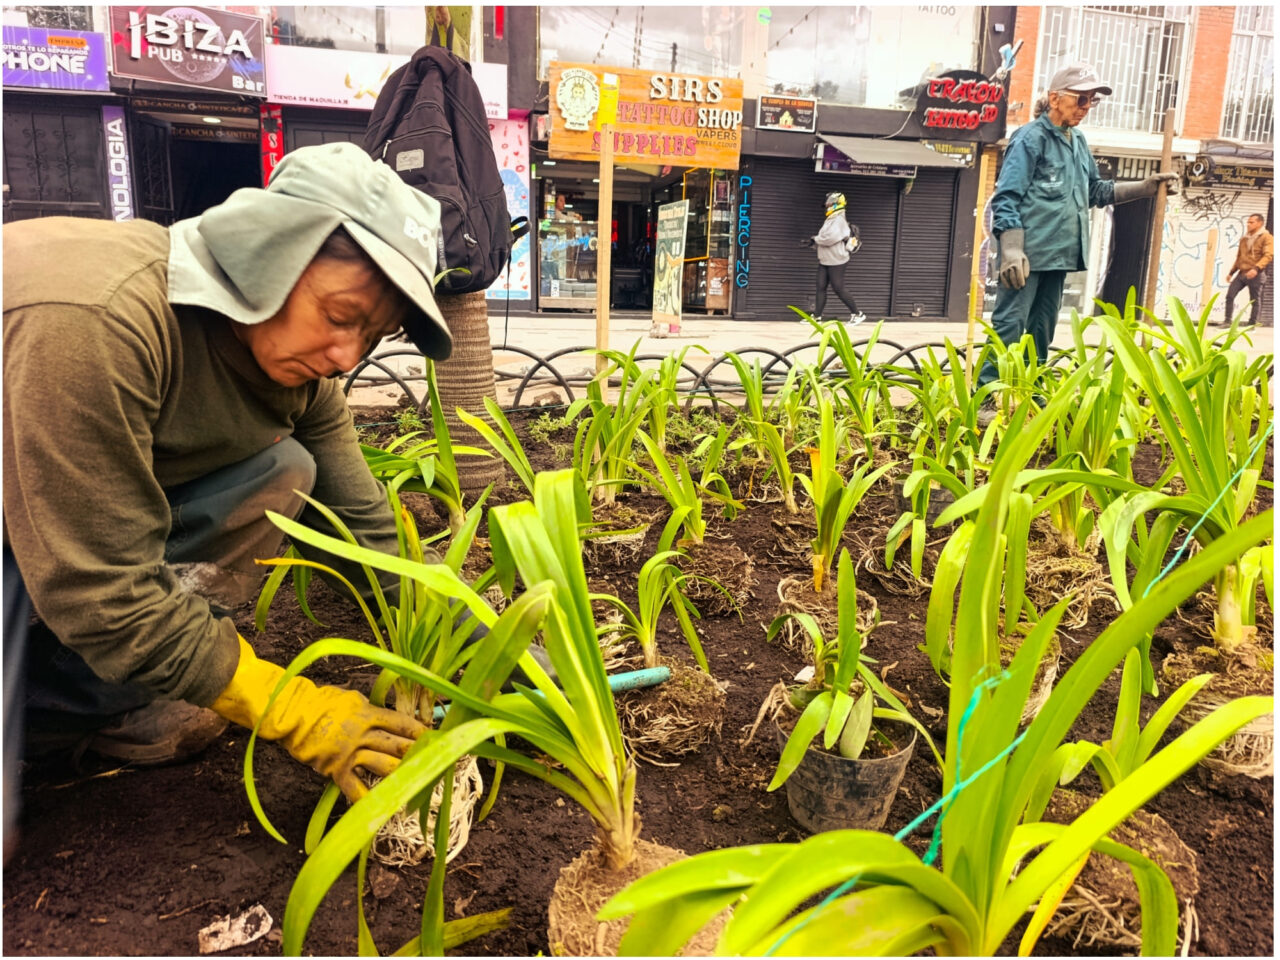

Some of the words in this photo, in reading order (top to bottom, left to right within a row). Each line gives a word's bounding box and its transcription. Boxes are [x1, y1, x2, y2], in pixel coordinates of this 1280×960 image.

[128, 10, 254, 60] IBIZA
[148, 46, 183, 62] PUB
[232, 75, 264, 92] Bar
[650, 74, 723, 103] SIRS
[928, 76, 1004, 104] ERAGON
[618, 102, 696, 127] TATTOO
[697, 108, 743, 131] SHOP
[924, 107, 980, 130] TATTOO
[179, 127, 214, 137] CANCHA
[696, 130, 737, 140] VAPERS
[736, 175, 753, 288] PIERCING
